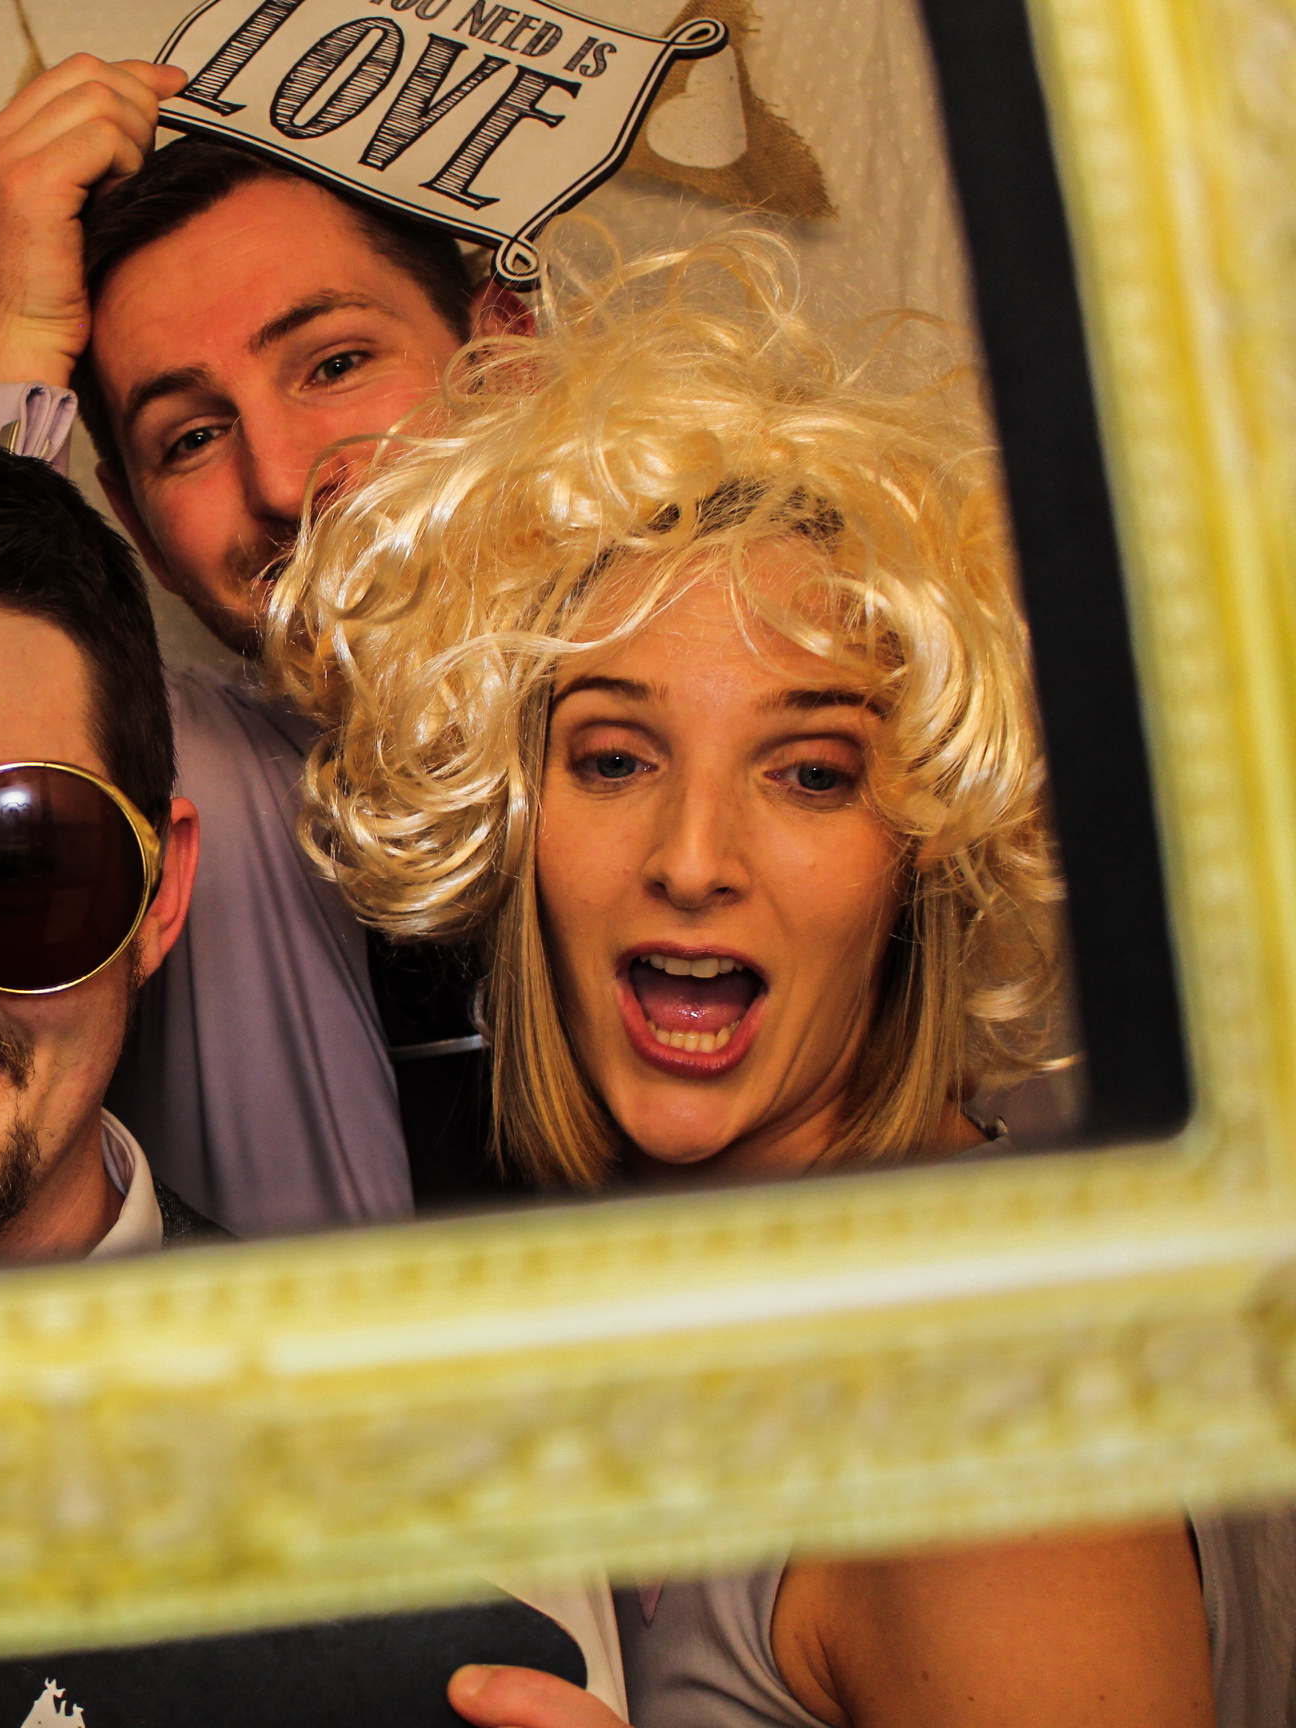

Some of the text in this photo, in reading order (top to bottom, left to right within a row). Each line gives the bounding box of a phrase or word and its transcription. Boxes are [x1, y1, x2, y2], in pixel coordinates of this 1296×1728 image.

[174, 0, 583, 211] LOVE
[452, 0, 563, 57] NEED
[563, 36, 617, 78] IS
